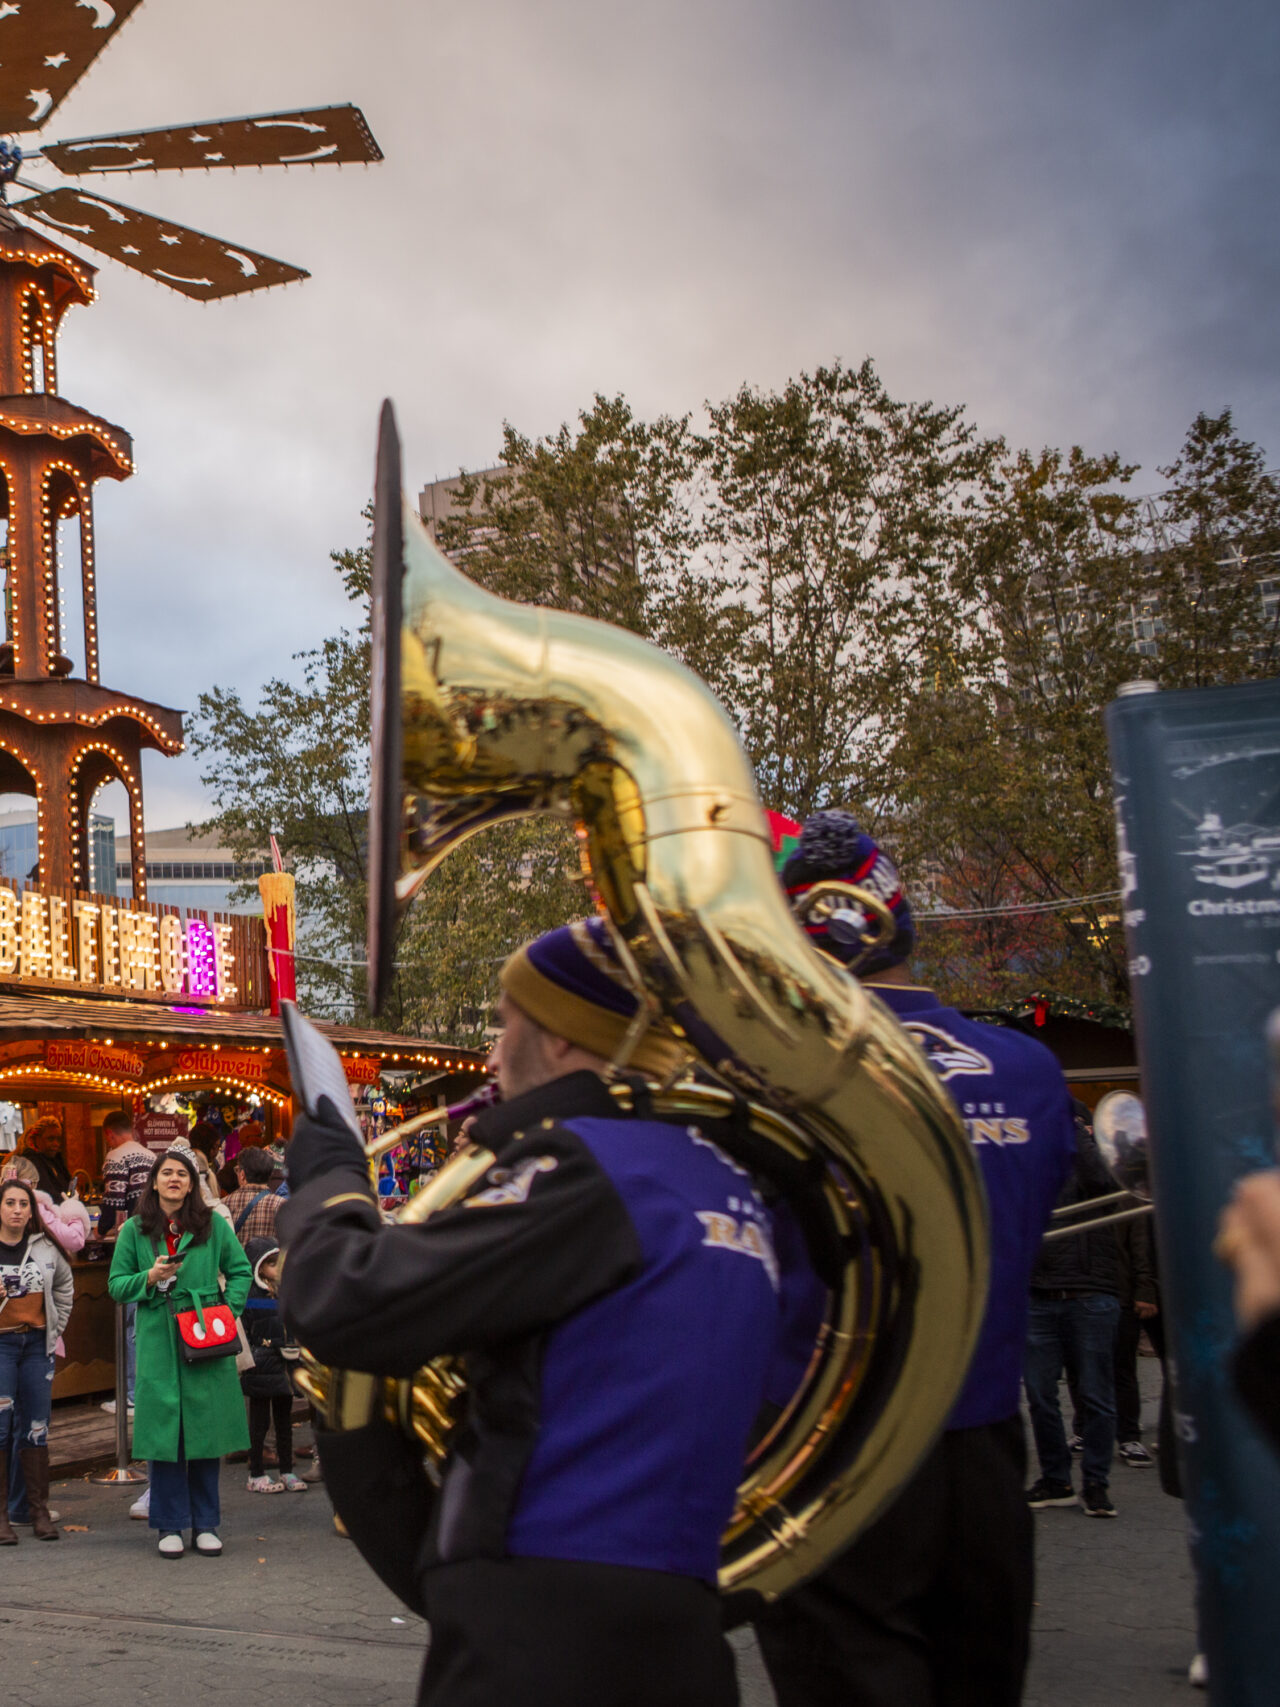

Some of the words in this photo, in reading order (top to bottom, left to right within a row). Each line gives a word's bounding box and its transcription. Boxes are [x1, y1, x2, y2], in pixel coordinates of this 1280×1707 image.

[48, 1046, 87, 1071] Spiked
[89, 1048, 143, 1077] Chocolate
[963, 1117, 1031, 1147] NS
